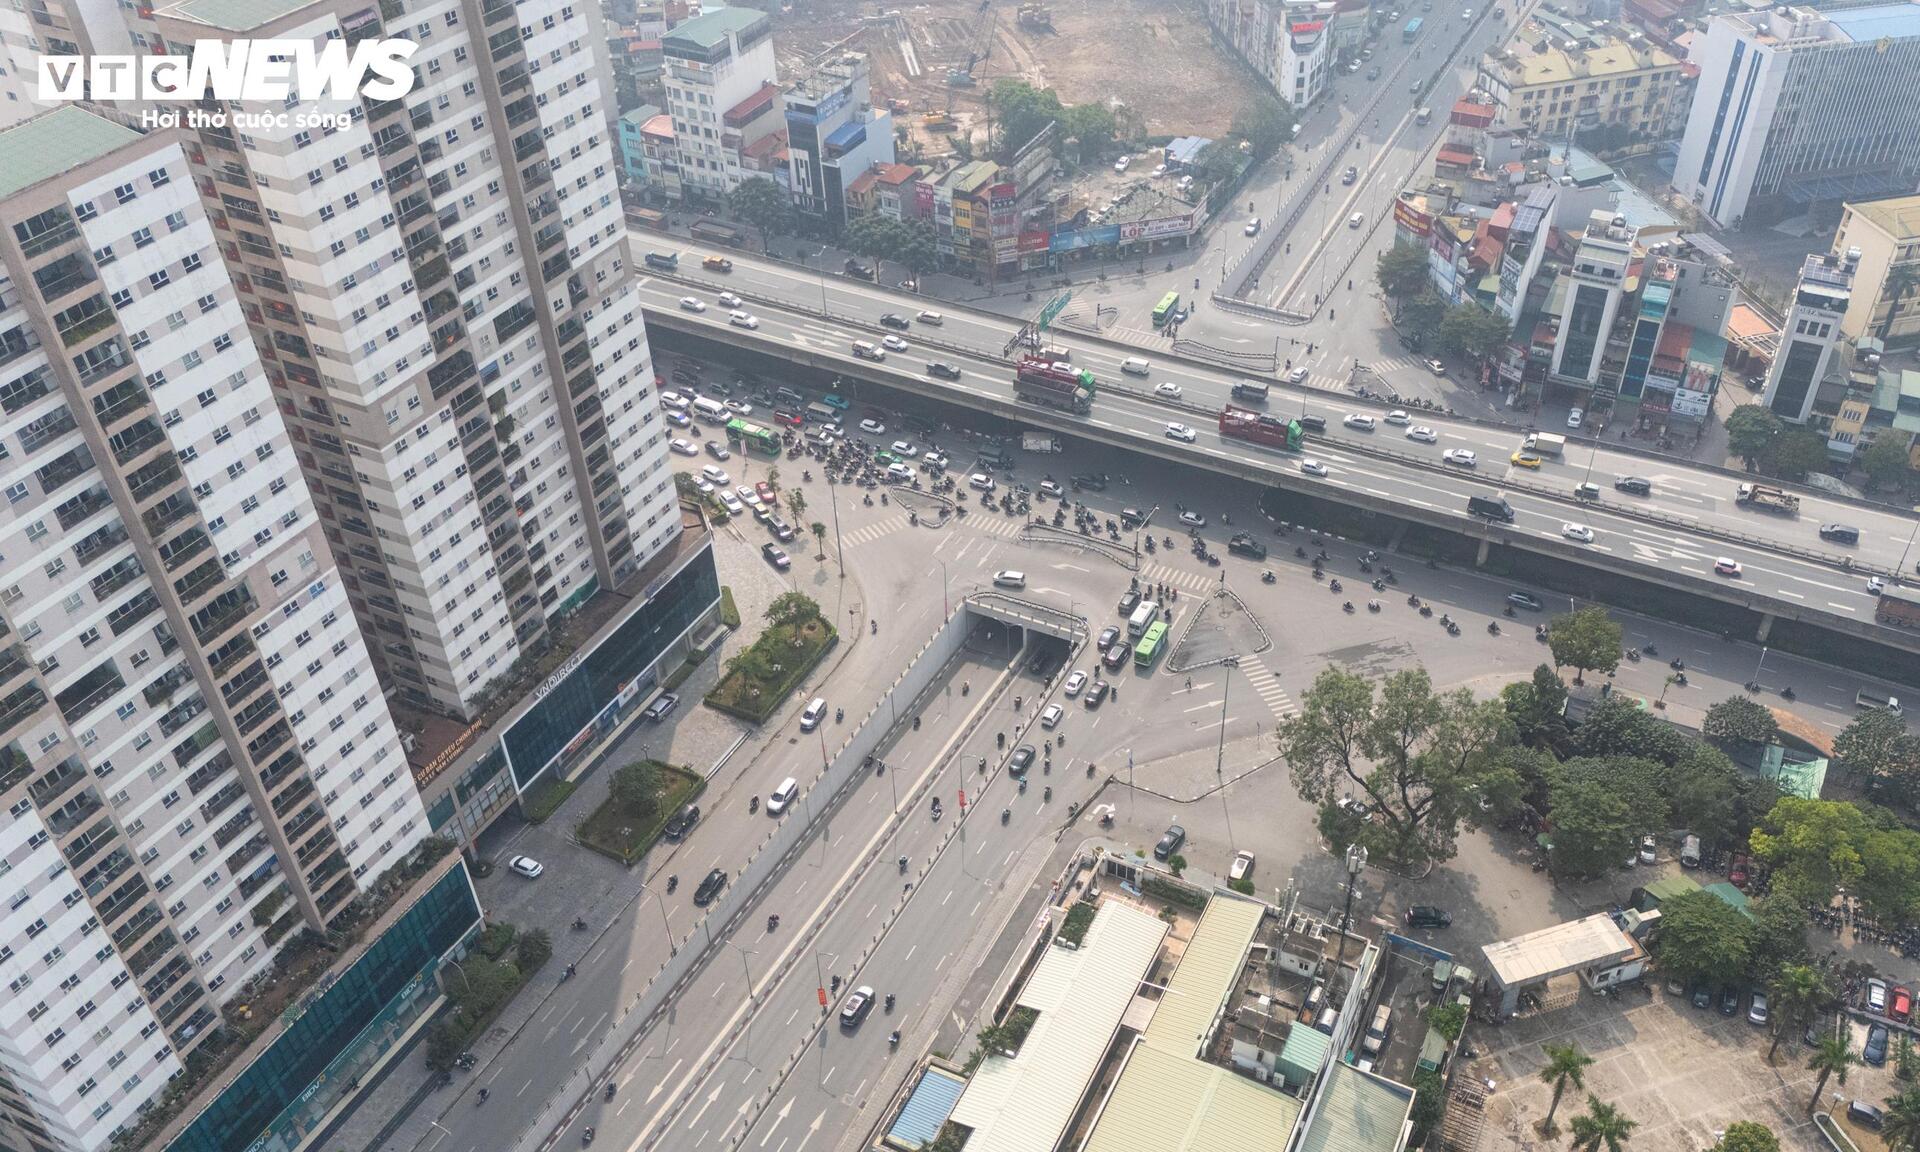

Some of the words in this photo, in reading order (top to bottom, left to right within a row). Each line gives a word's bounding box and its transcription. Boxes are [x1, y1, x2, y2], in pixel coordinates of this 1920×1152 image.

[535, 652, 582, 699] VNDIRECT
[401, 980, 417, 999] BIDV
[302, 1081, 320, 1102] BIDV
